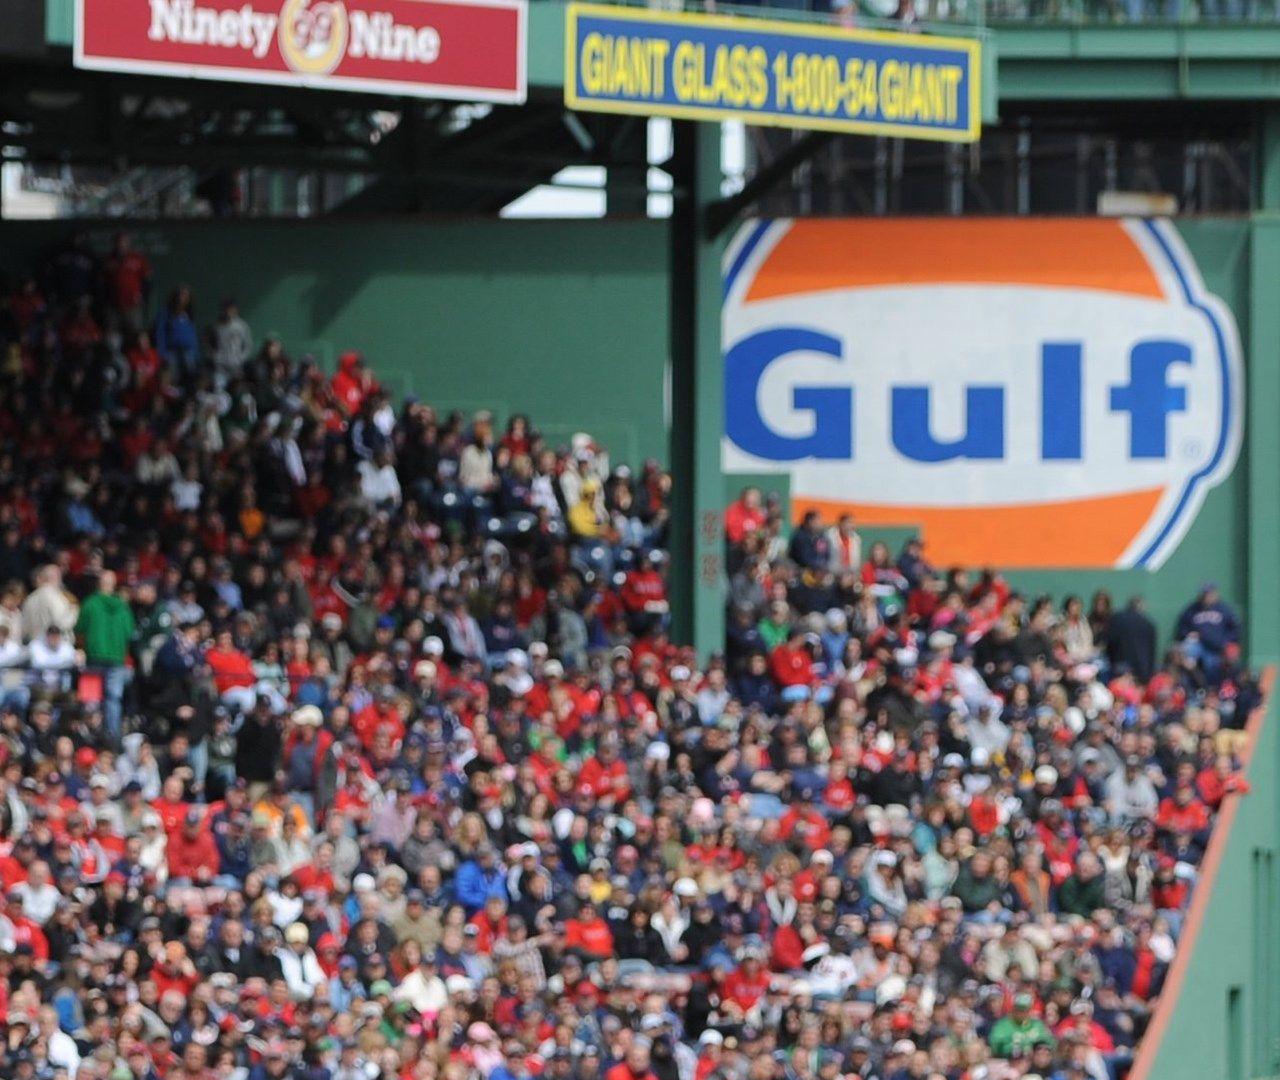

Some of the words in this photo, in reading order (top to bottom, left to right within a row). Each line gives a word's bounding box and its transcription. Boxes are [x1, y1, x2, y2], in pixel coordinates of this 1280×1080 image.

[148, 0, 277, 58] Ninety
[348, 10, 441, 63] Nine
[581, 32, 669, 97] GIANT
[673, 40, 769, 107] GLASS
[879, 59, 962, 124] GIANT
[725, 326, 1194, 462] Gulf
